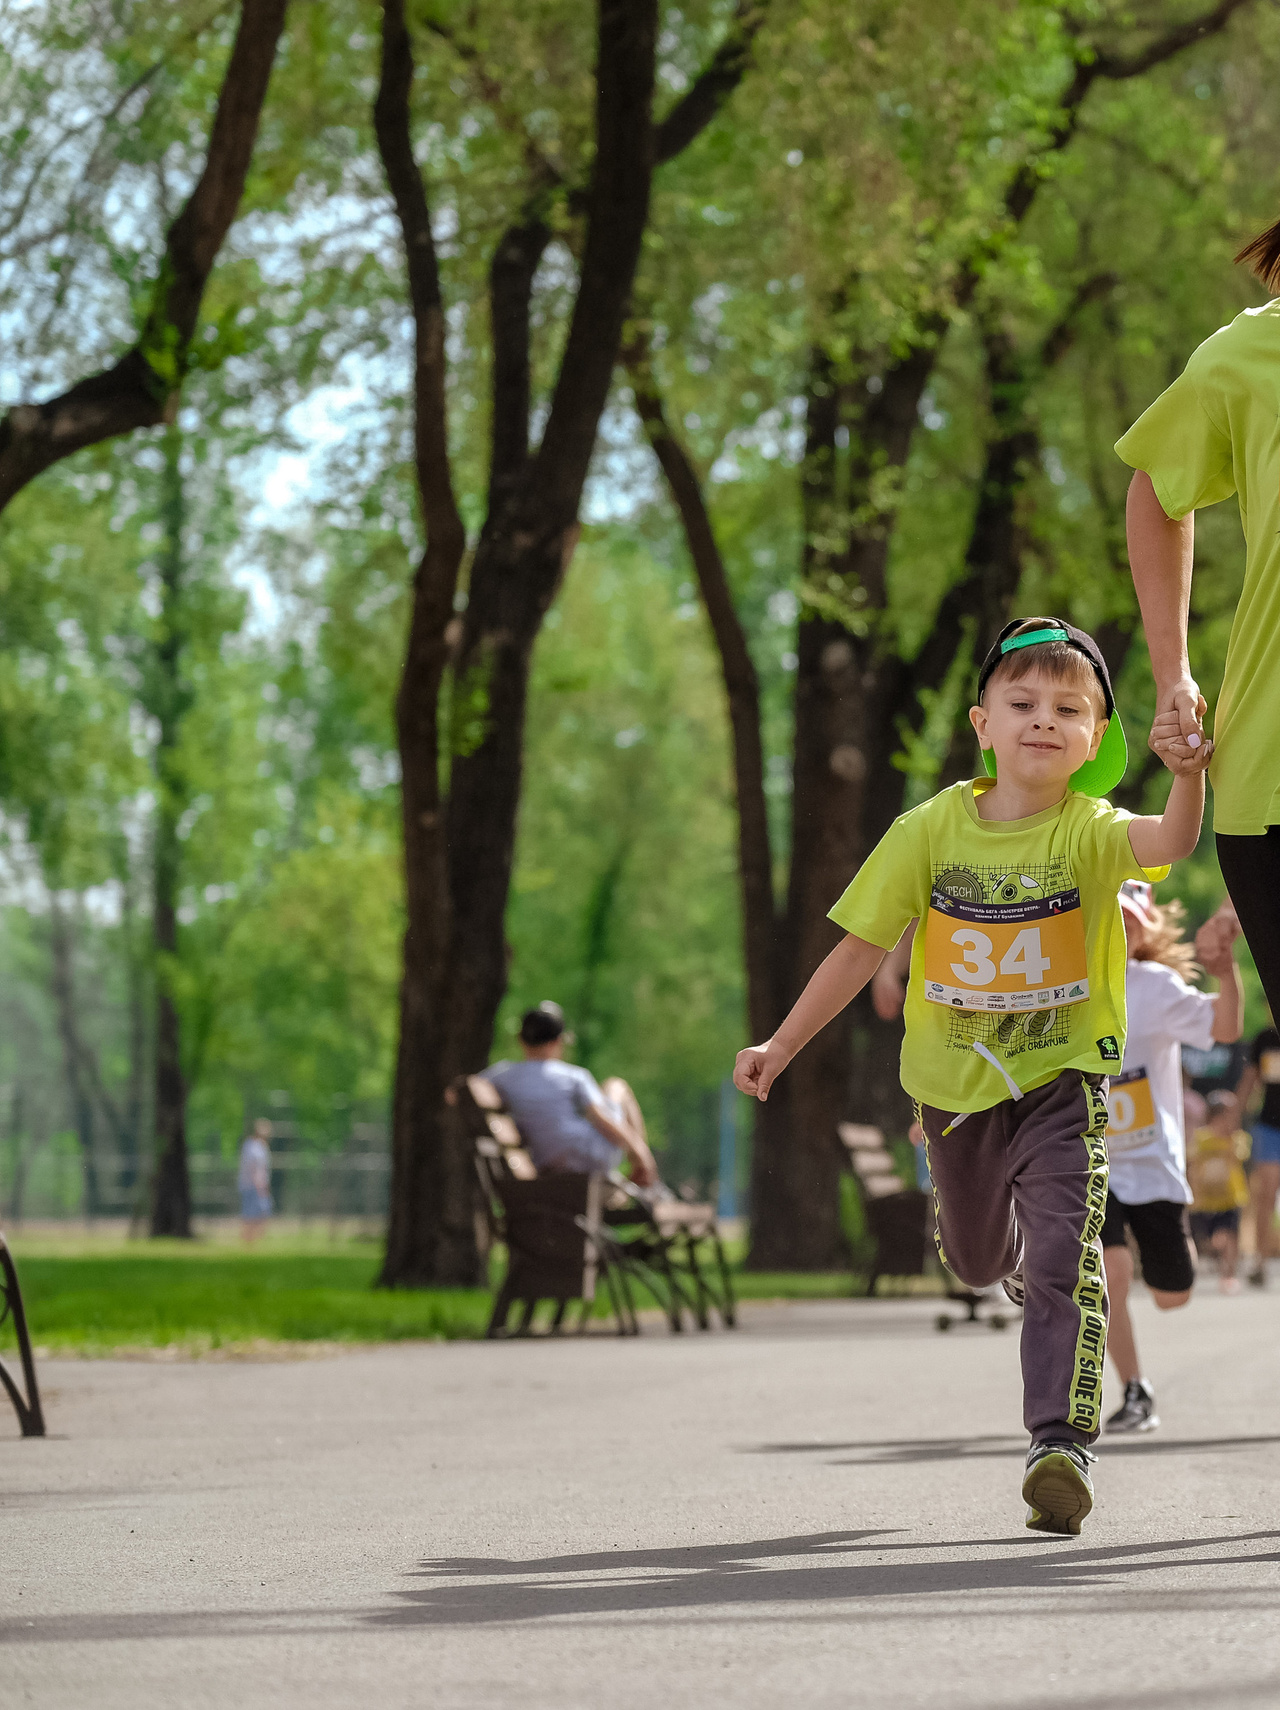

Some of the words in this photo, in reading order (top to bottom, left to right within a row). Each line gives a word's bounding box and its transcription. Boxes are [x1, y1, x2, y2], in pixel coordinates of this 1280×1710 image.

[946, 885, 972, 898] TECH
[950, 927, 1051, 986] 34
[1083, 1246, 1100, 1273] GO
[1082, 1315, 1103, 1356] OUT
[1075, 1356, 1099, 1402] SIDE
[1073, 1402, 1095, 1430] GO
